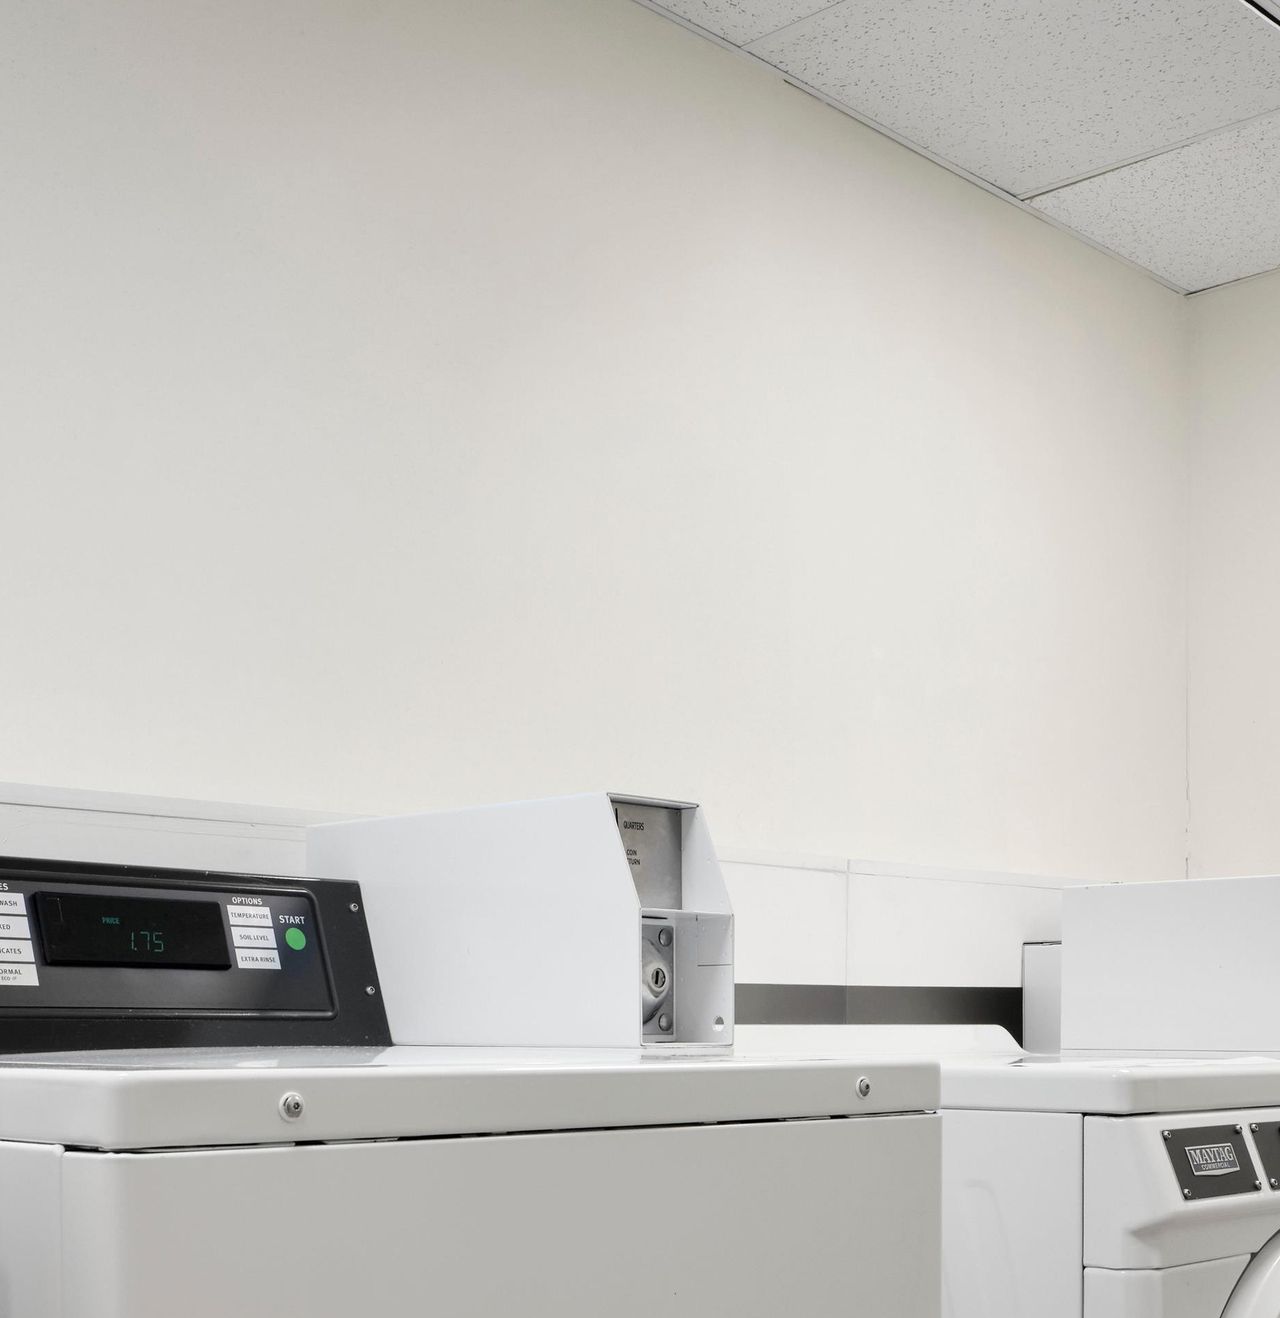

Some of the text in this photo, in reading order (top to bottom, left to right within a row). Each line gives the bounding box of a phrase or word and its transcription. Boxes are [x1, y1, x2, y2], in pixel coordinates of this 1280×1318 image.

[623, 821, 645, 831] QUARTERS
[231, 897, 263, 905] OPTIONS
[230, 912, 269, 920] TEMPERATURE
[279, 915, 305, 924] START
[131, 931, 164, 952] 1.75
[1189, 1146, 1234, 1164] MAYTAG
